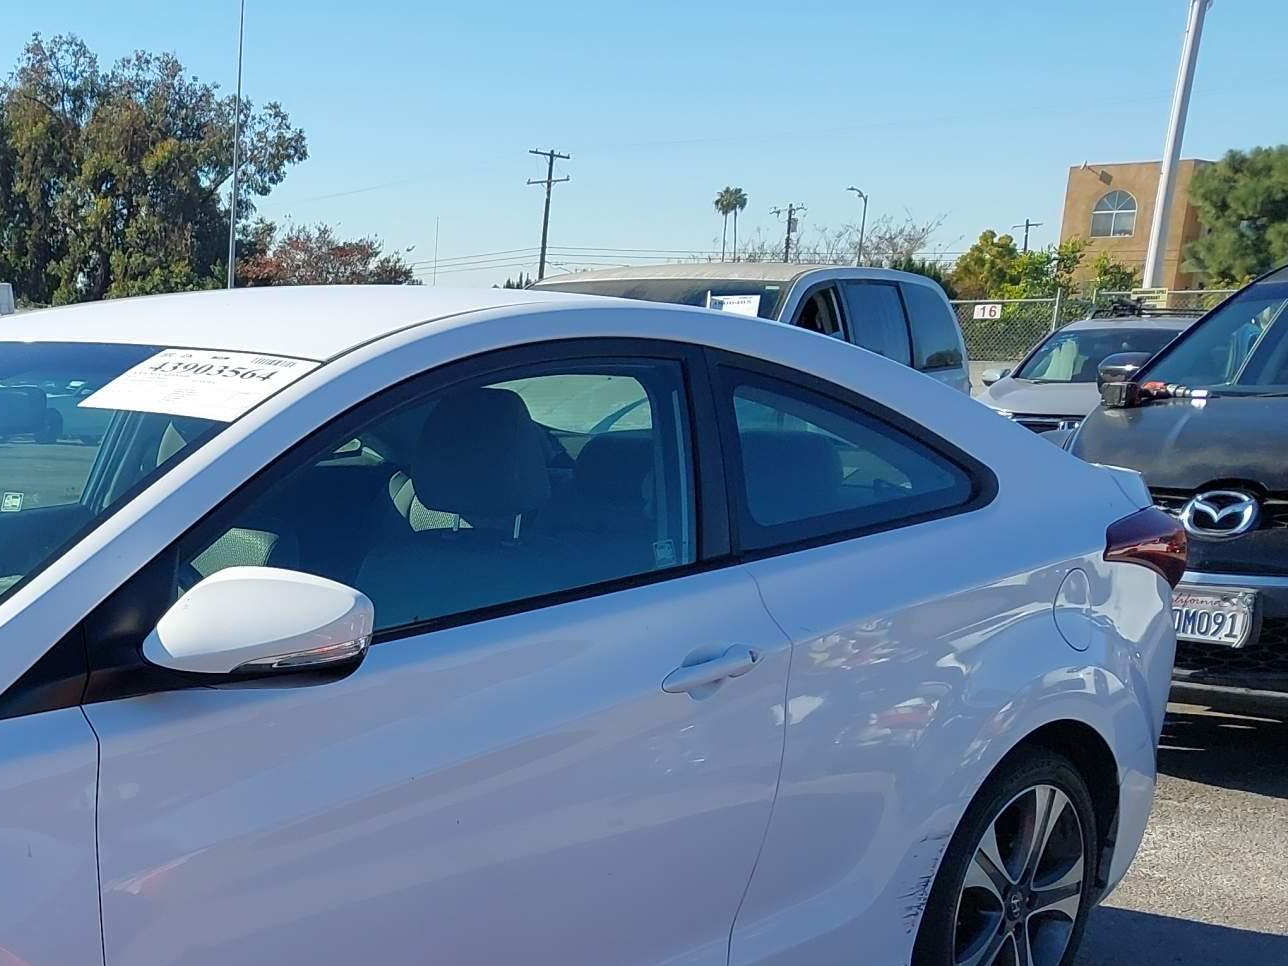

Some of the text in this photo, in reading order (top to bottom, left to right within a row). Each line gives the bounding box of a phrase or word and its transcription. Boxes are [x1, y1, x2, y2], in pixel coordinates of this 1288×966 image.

[980, 305, 998, 318] 16
[149, 361, 279, 382] 43903564
[1172, 593, 1224, 608] lifornia
